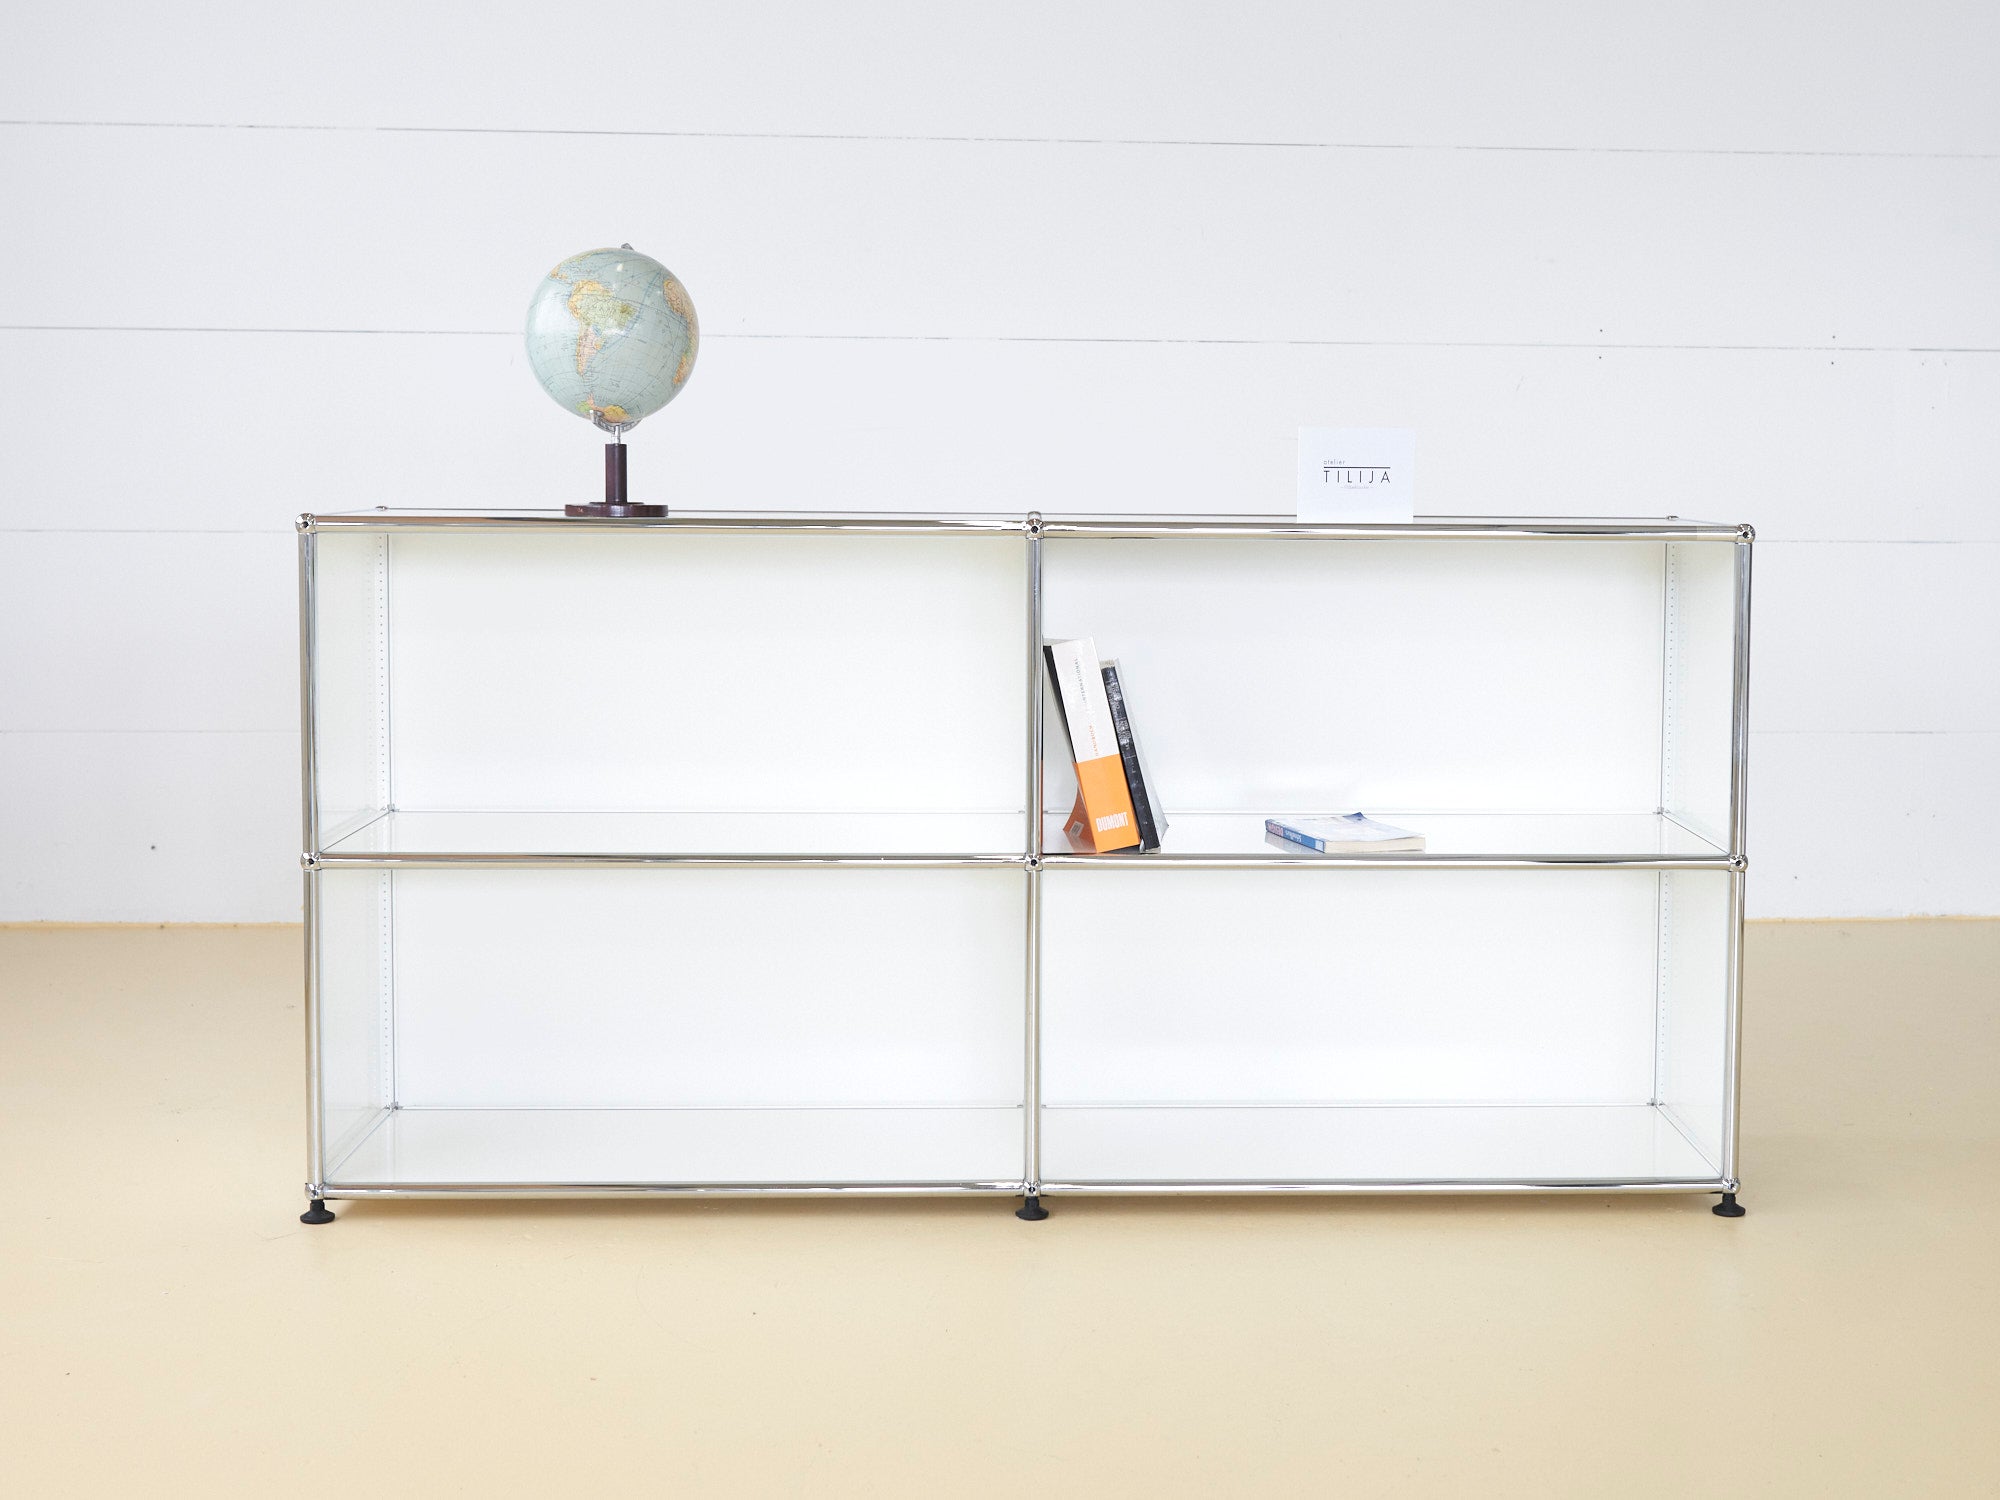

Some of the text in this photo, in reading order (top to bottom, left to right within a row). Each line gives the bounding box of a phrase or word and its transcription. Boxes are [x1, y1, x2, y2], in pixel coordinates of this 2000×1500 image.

[1323, 458, 1346, 466] atelier
[1323, 470, 1391, 483] TILIJA
[1095, 811, 1129, 832] DUMONT
